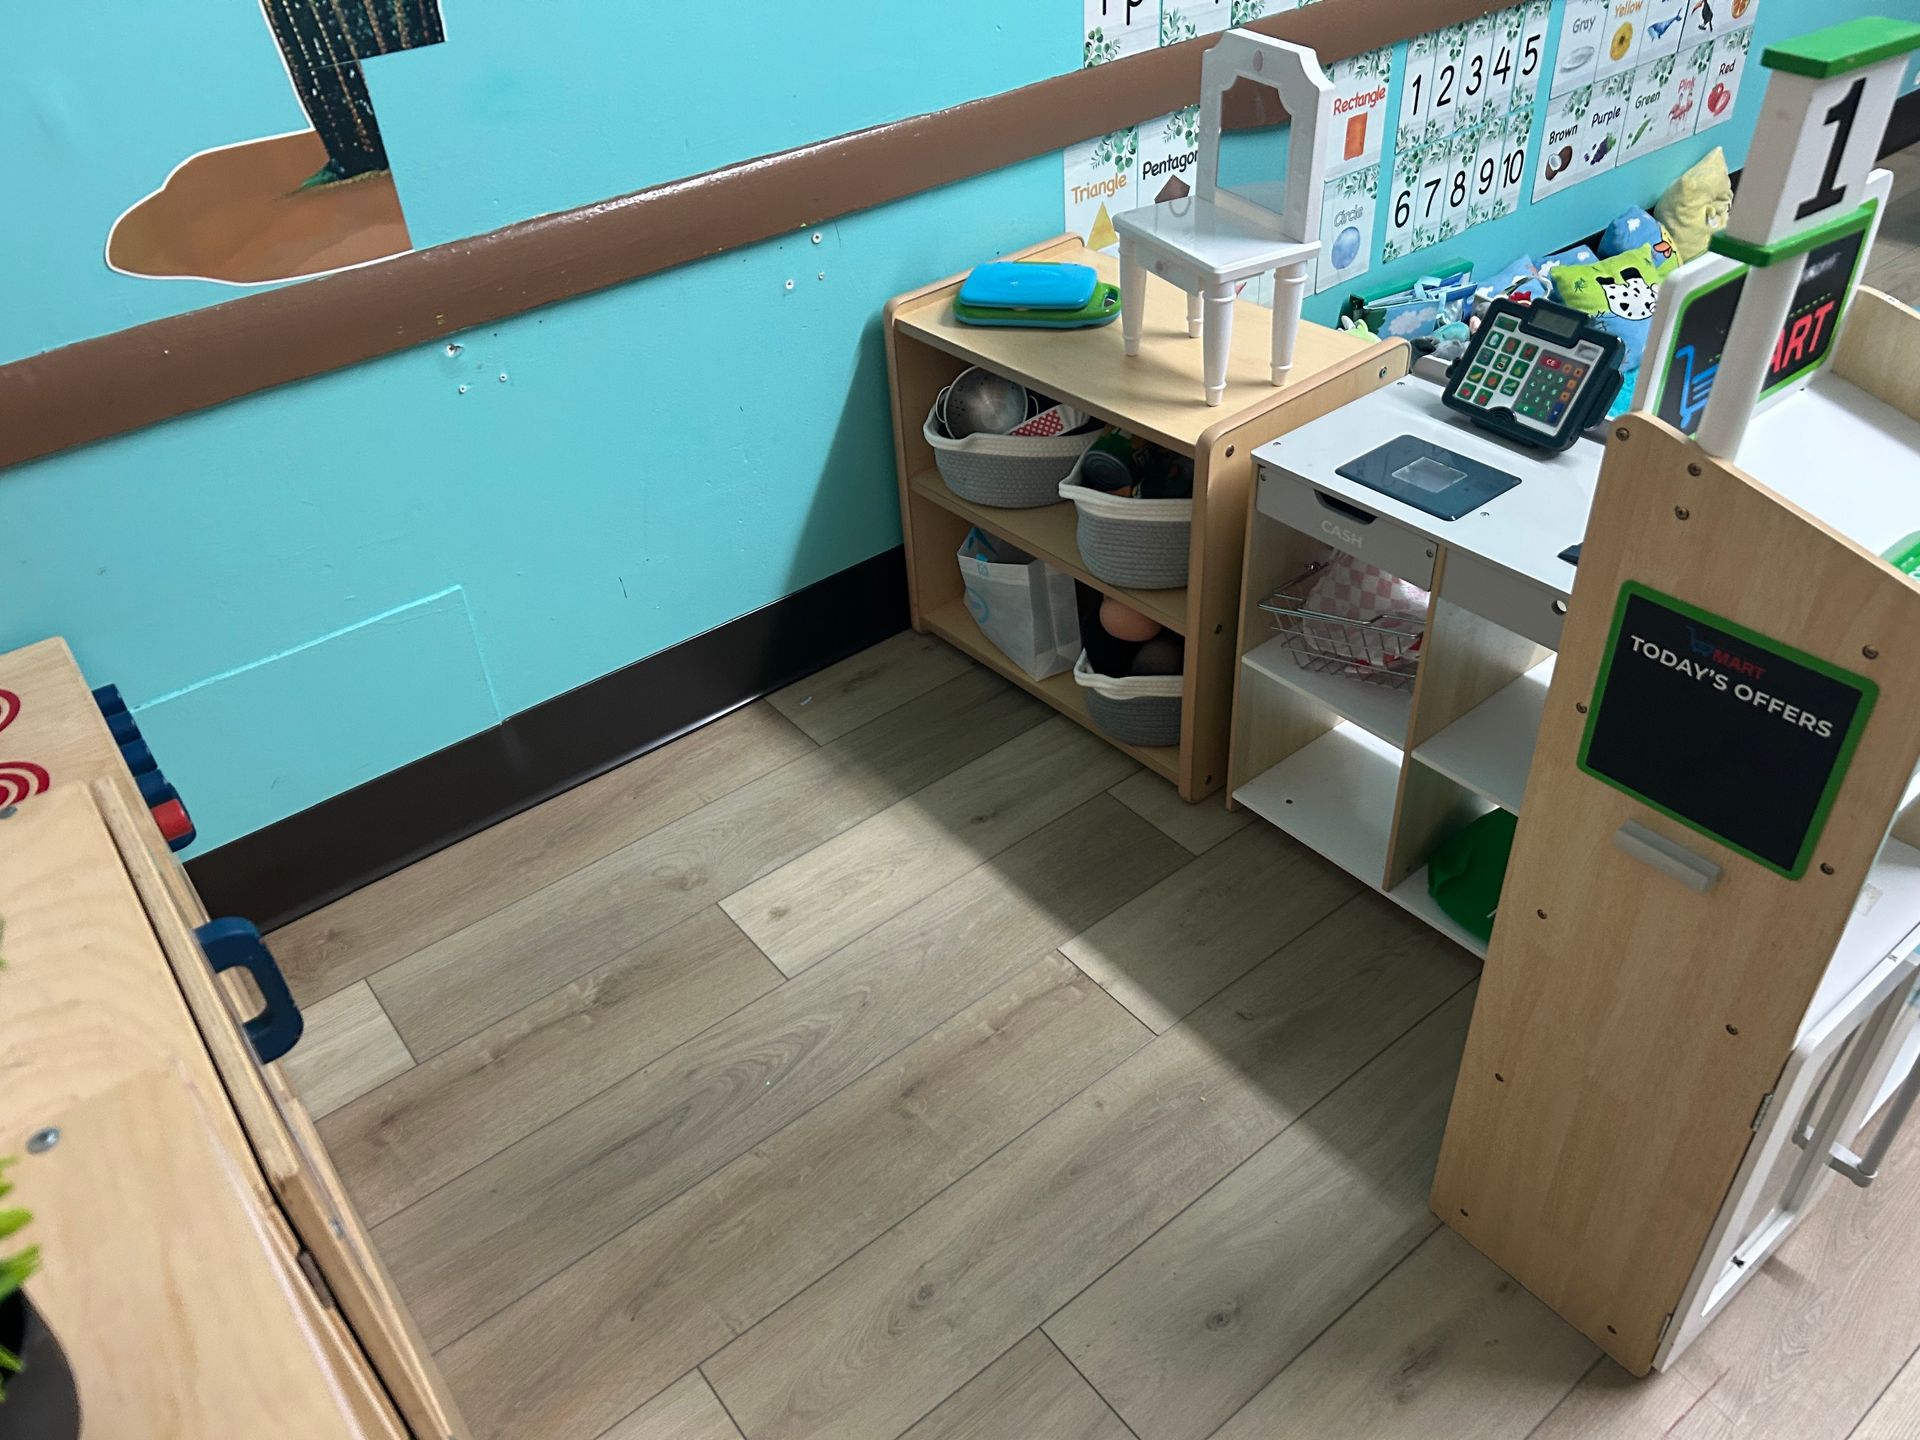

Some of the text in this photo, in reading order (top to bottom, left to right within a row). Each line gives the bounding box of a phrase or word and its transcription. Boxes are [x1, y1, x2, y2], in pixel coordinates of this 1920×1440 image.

[1615, 0, 1643, 17] Yellow
[1572, 16, 1597, 34] Gray
[1412, 34, 1541, 115] 1 2 3 4 5
[1718, 59, 1736, 76] Red
[1333, 85, 1386, 115] Rectangle
[1635, 91, 1660, 109] Green
[1677, 77, 1696, 94] Pink
[1591, 105, 1621, 127] Purple
[1548, 124, 1578, 145] Brown
[1794, 77, 1867, 221] 1
[1071, 173, 1127, 204] Triangle
[1394, 149, 1525, 229] 6 7 8 9 10
[1333, 204, 1364, 228] Circle
[1771, 301, 1835, 373] ART
[1321, 520, 1362, 549] CASH
[1712, 648, 1767, 680] MART
[1630, 634, 1834, 738] TODAY'S OFFERS
